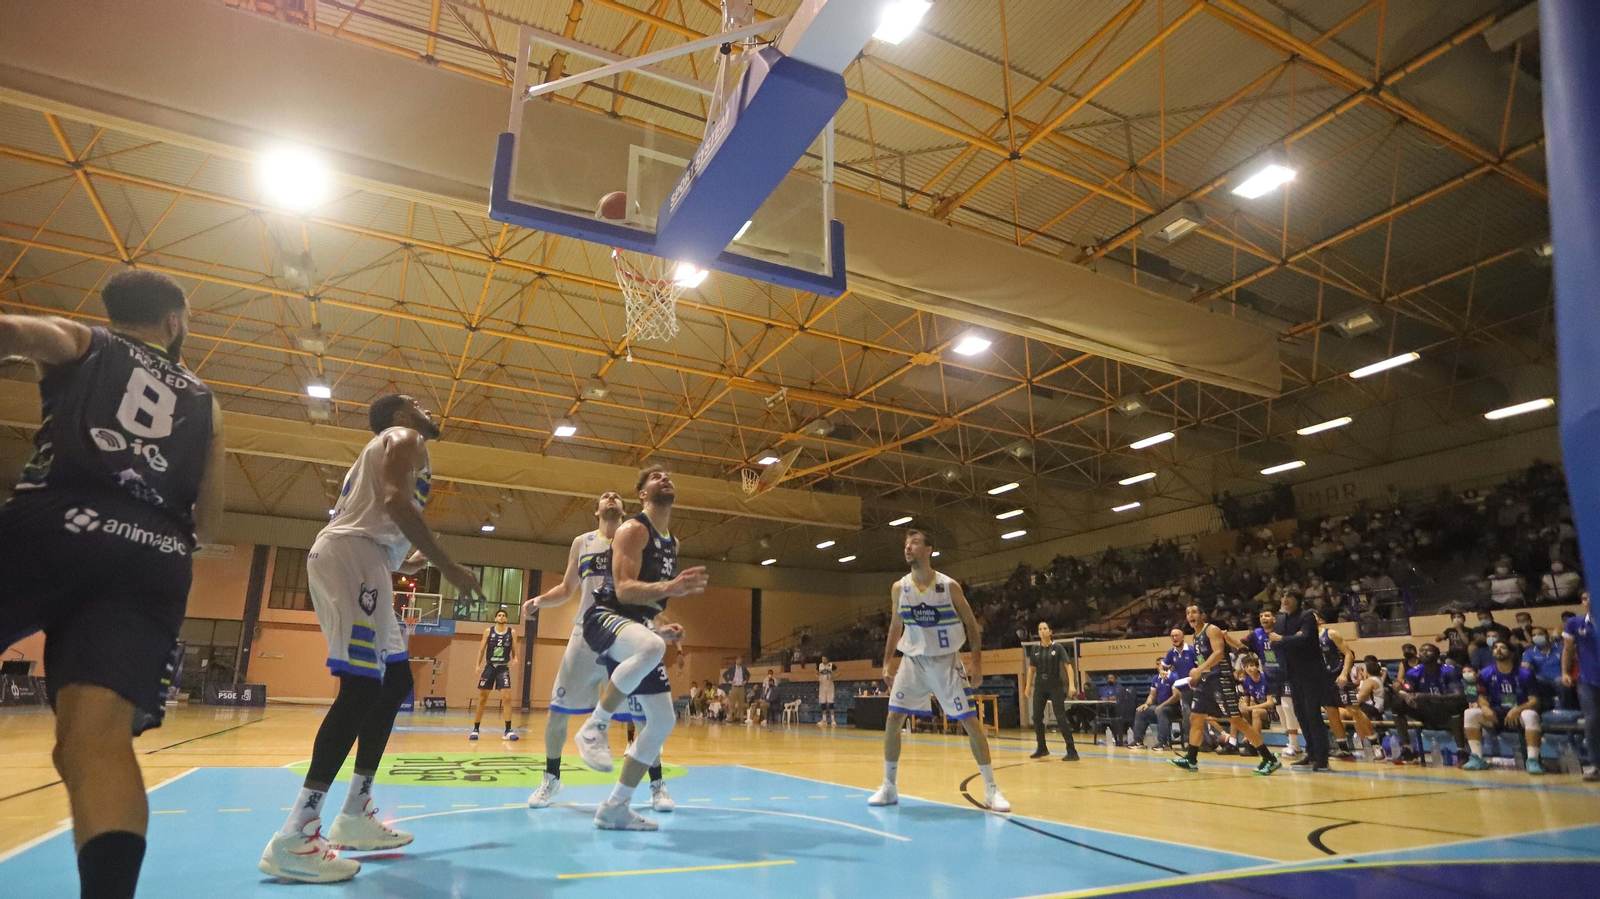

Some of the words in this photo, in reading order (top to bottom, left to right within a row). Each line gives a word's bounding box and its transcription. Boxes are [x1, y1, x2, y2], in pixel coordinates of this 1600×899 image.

[115, 367, 178, 438] 8
[102, 518, 187, 556] animagic
[661, 556, 673, 576] 35
[496, 638, 504, 647] 2
[937, 628, 950, 648] 6
[218, 692, 238, 700] PSOE
[1501, 683, 1513, 693] 10
[953, 696, 964, 712] 6
